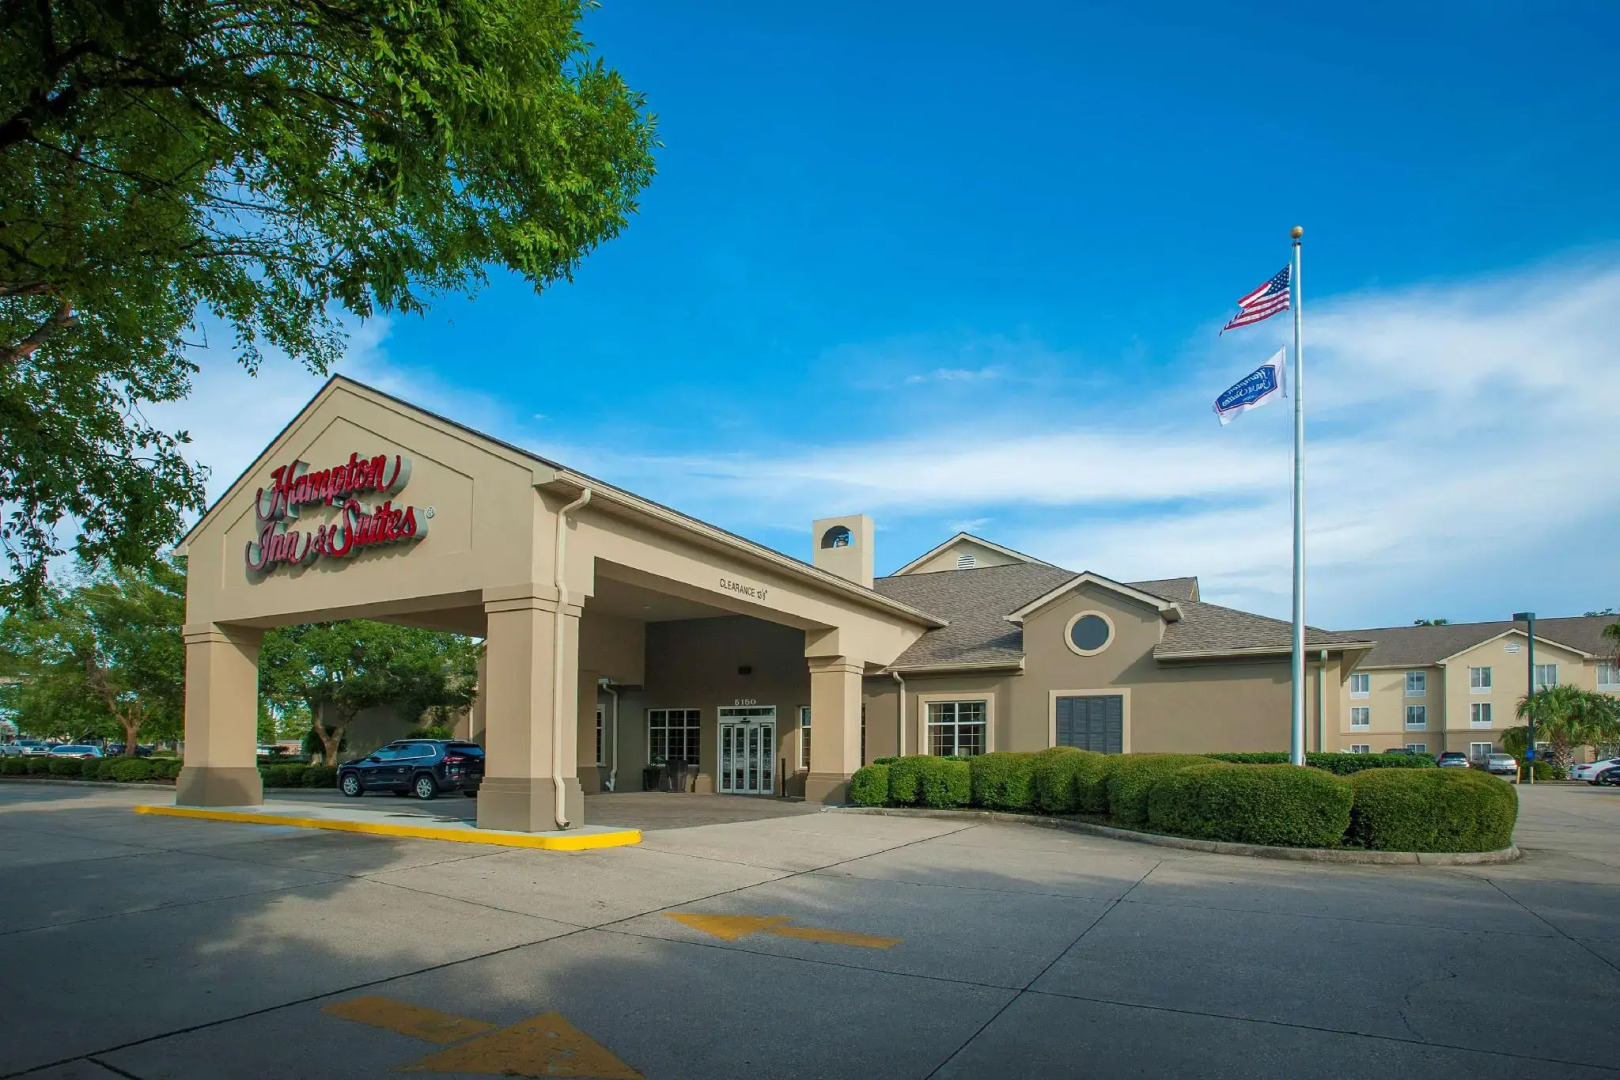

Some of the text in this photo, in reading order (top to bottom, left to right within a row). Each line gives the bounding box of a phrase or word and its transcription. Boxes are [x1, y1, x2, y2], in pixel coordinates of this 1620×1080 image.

[256, 452, 401, 521] Hampton
[245, 499, 417, 570] Inn & Suites
[720, 578, 755, 597] CLEARANCE
